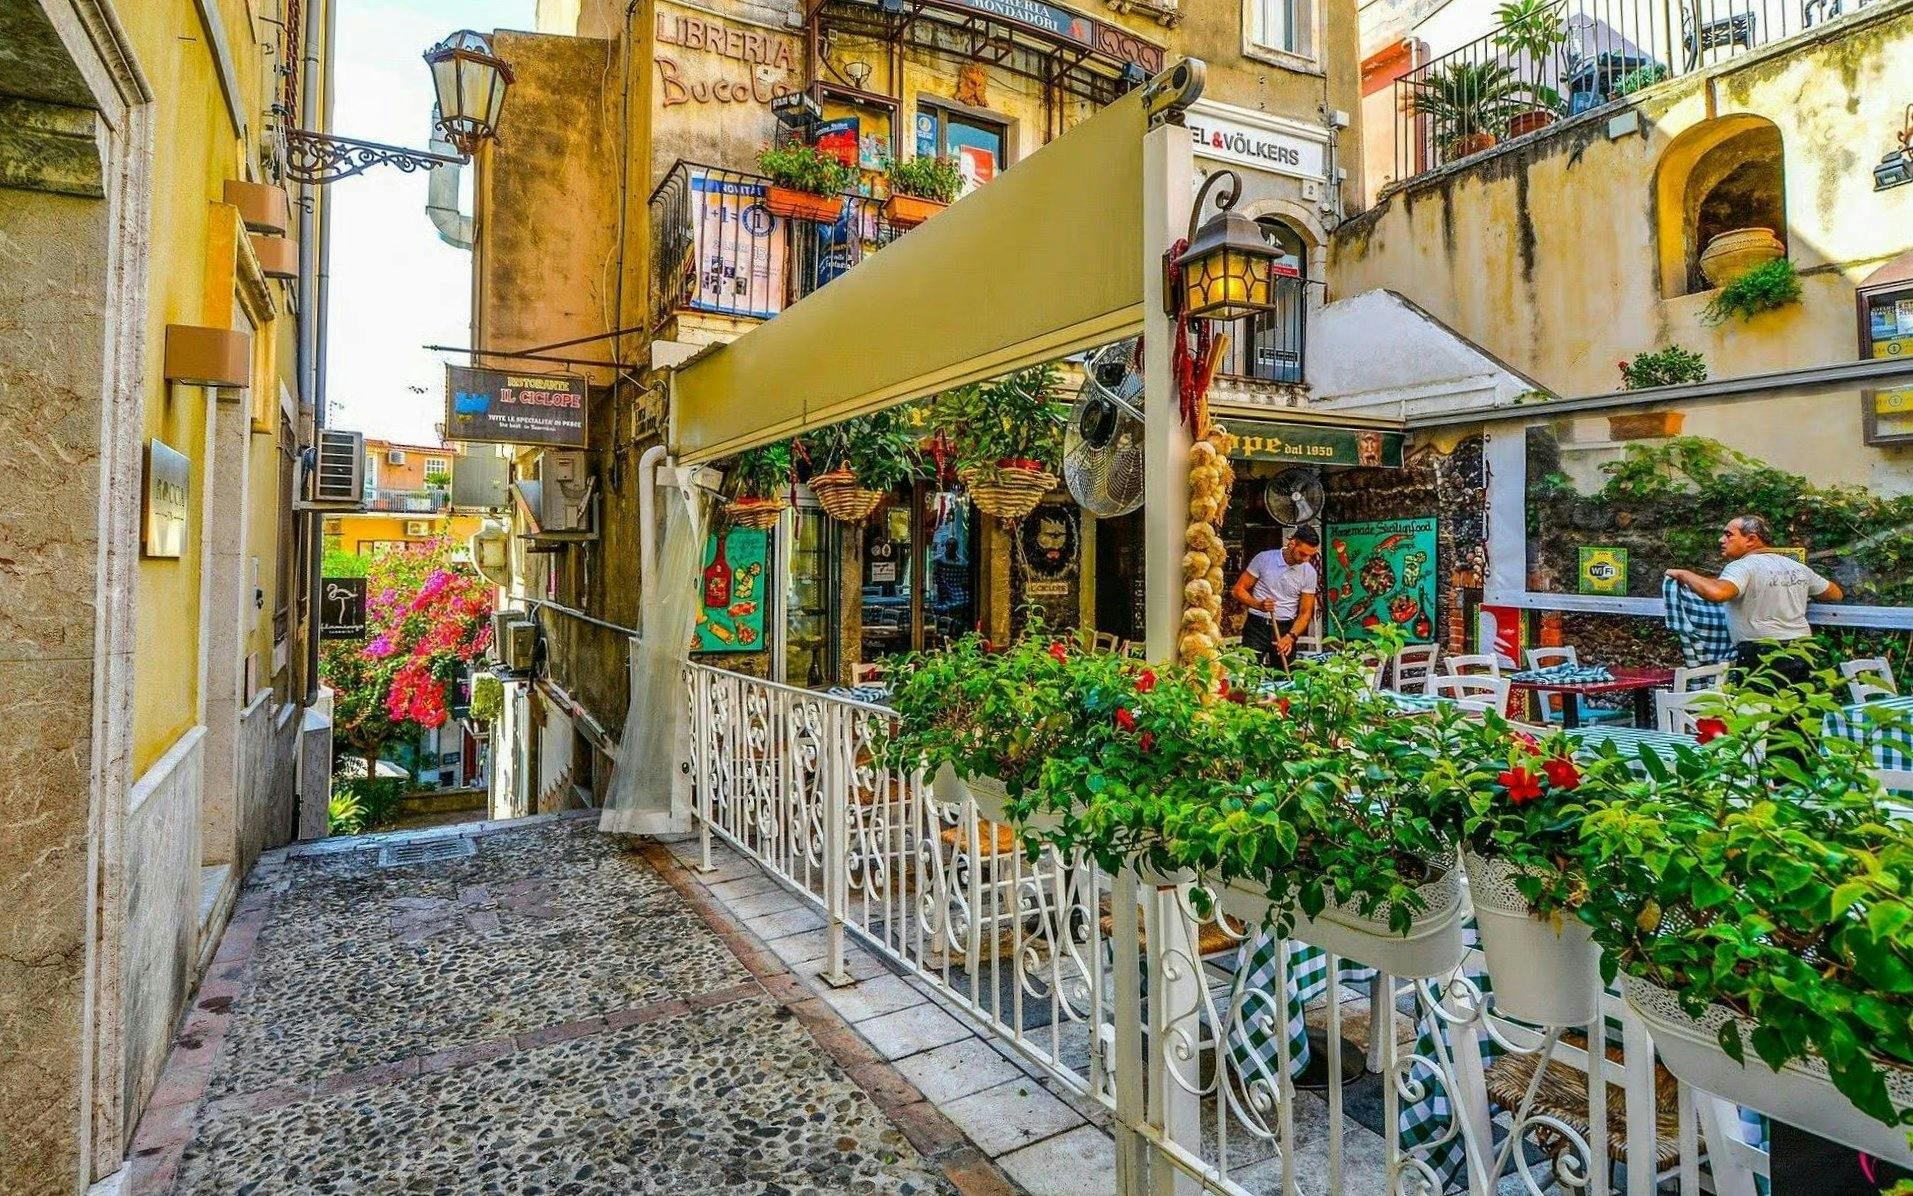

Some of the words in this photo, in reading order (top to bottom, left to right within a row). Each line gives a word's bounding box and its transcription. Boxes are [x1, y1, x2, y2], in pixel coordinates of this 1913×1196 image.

[656, 12, 794, 70] LIBRERIA
[1307, 185, 1314, 195] 2
[507, 377, 569, 391] RISTORANTE
[500, 388, 516, 403] IL
[520, 390, 581, 409] CICLOPE
[1284, 443, 1302, 455] dal
[1306, 445, 1333, 457] 1950
